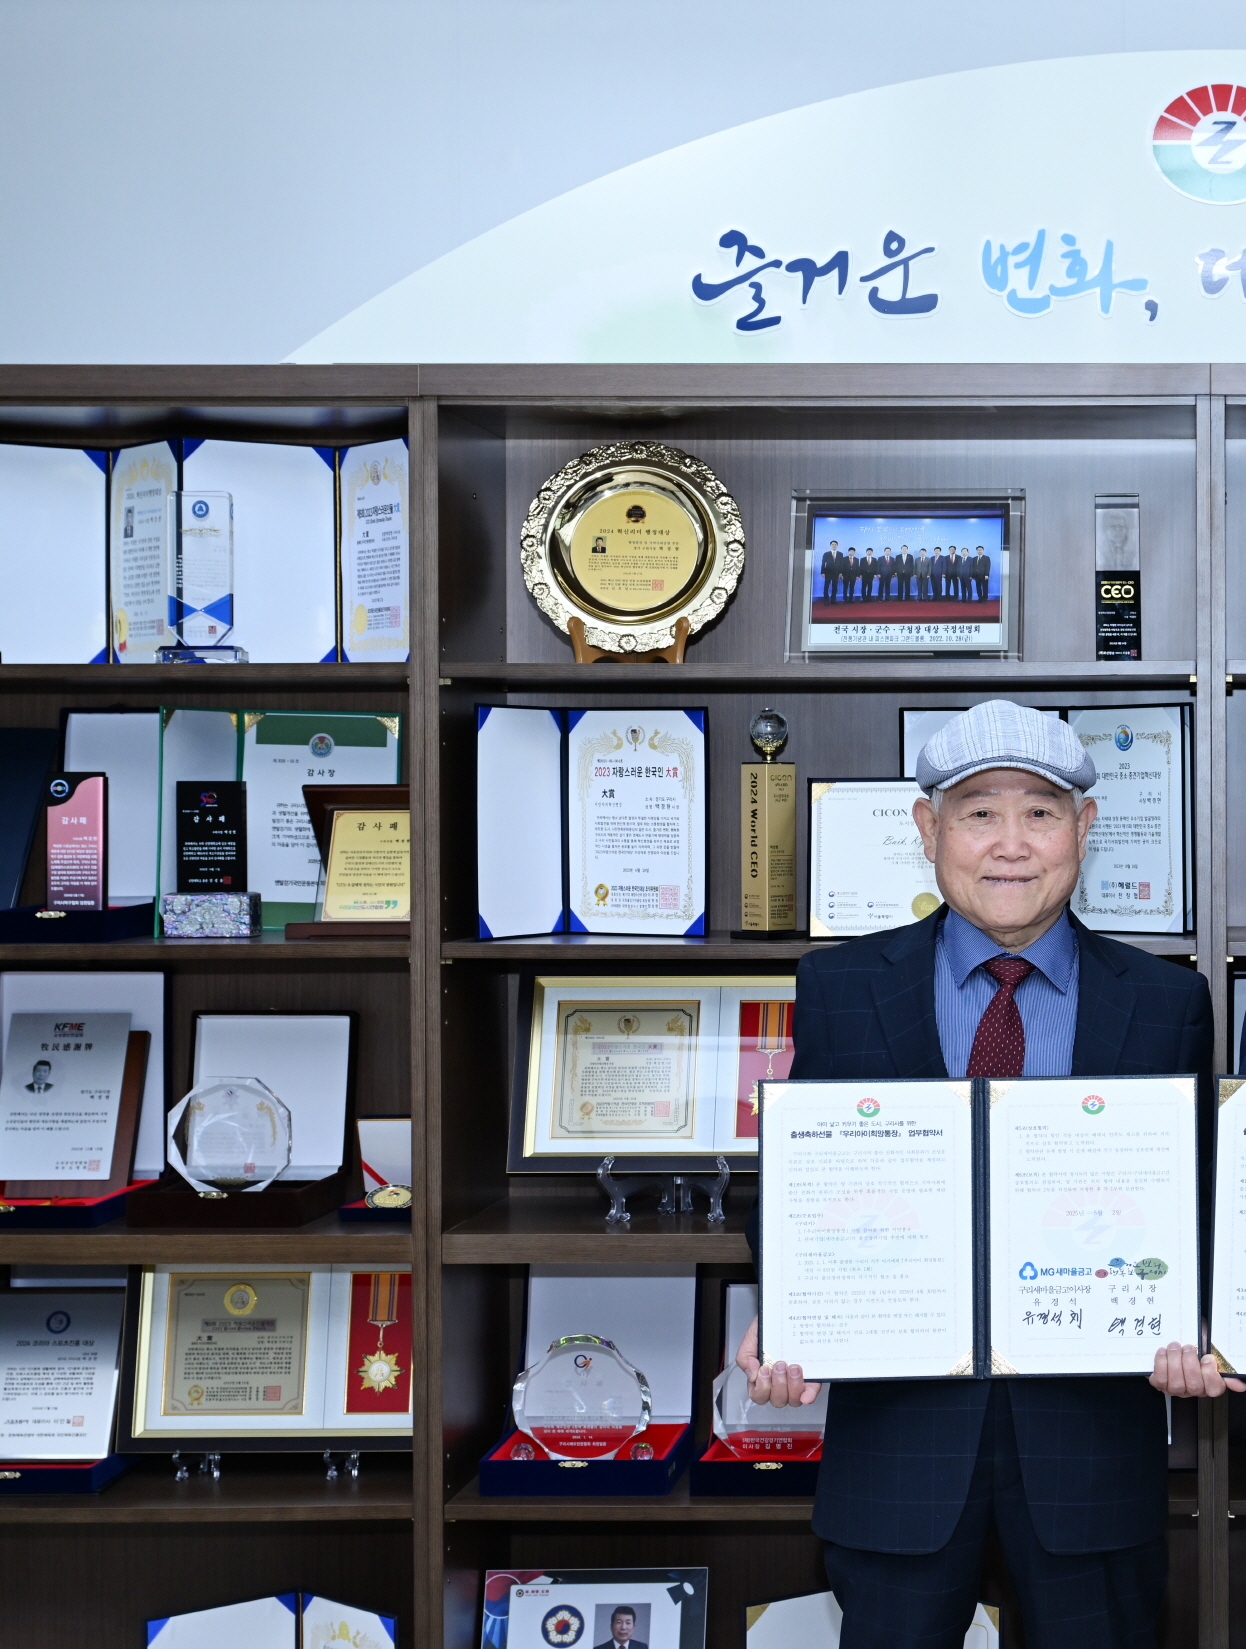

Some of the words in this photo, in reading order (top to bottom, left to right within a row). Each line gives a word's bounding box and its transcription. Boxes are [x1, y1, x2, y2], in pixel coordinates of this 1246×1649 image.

[691, 229, 937, 334] 즐거운
[984, 227, 1159, 324] 변화,
[1101, 585, 1134, 598] CEO
[834, 626, 848, 634] 전국
[852, 625, 866, 634] 시장
[875, 626, 889, 634] 군수
[898, 626, 920, 634] 구청장
[924, 625, 939, 634] 대상
[942, 625, 980, 634] 국정설명회
[307, 769, 335, 777] 감사장
[595, 767, 610, 777] 2023
[612, 767, 643, 777] 자랑스러운
[645, 767, 663, 777] 한국인
[1102, 772, 1118, 780] 대한민국
[602, 789, 615, 798] 大賞
[357, 822, 398, 831] 감사패
[54, 1023, 85, 1031] KFME
[909, 1129, 943, 1137] 업무협약서
[1041, 1268, 1054, 1276] MG
[1056, 1268, 1092, 1276] 새마을금고
[1019, 1286, 1091, 1294] 구리새마을금고이사장
